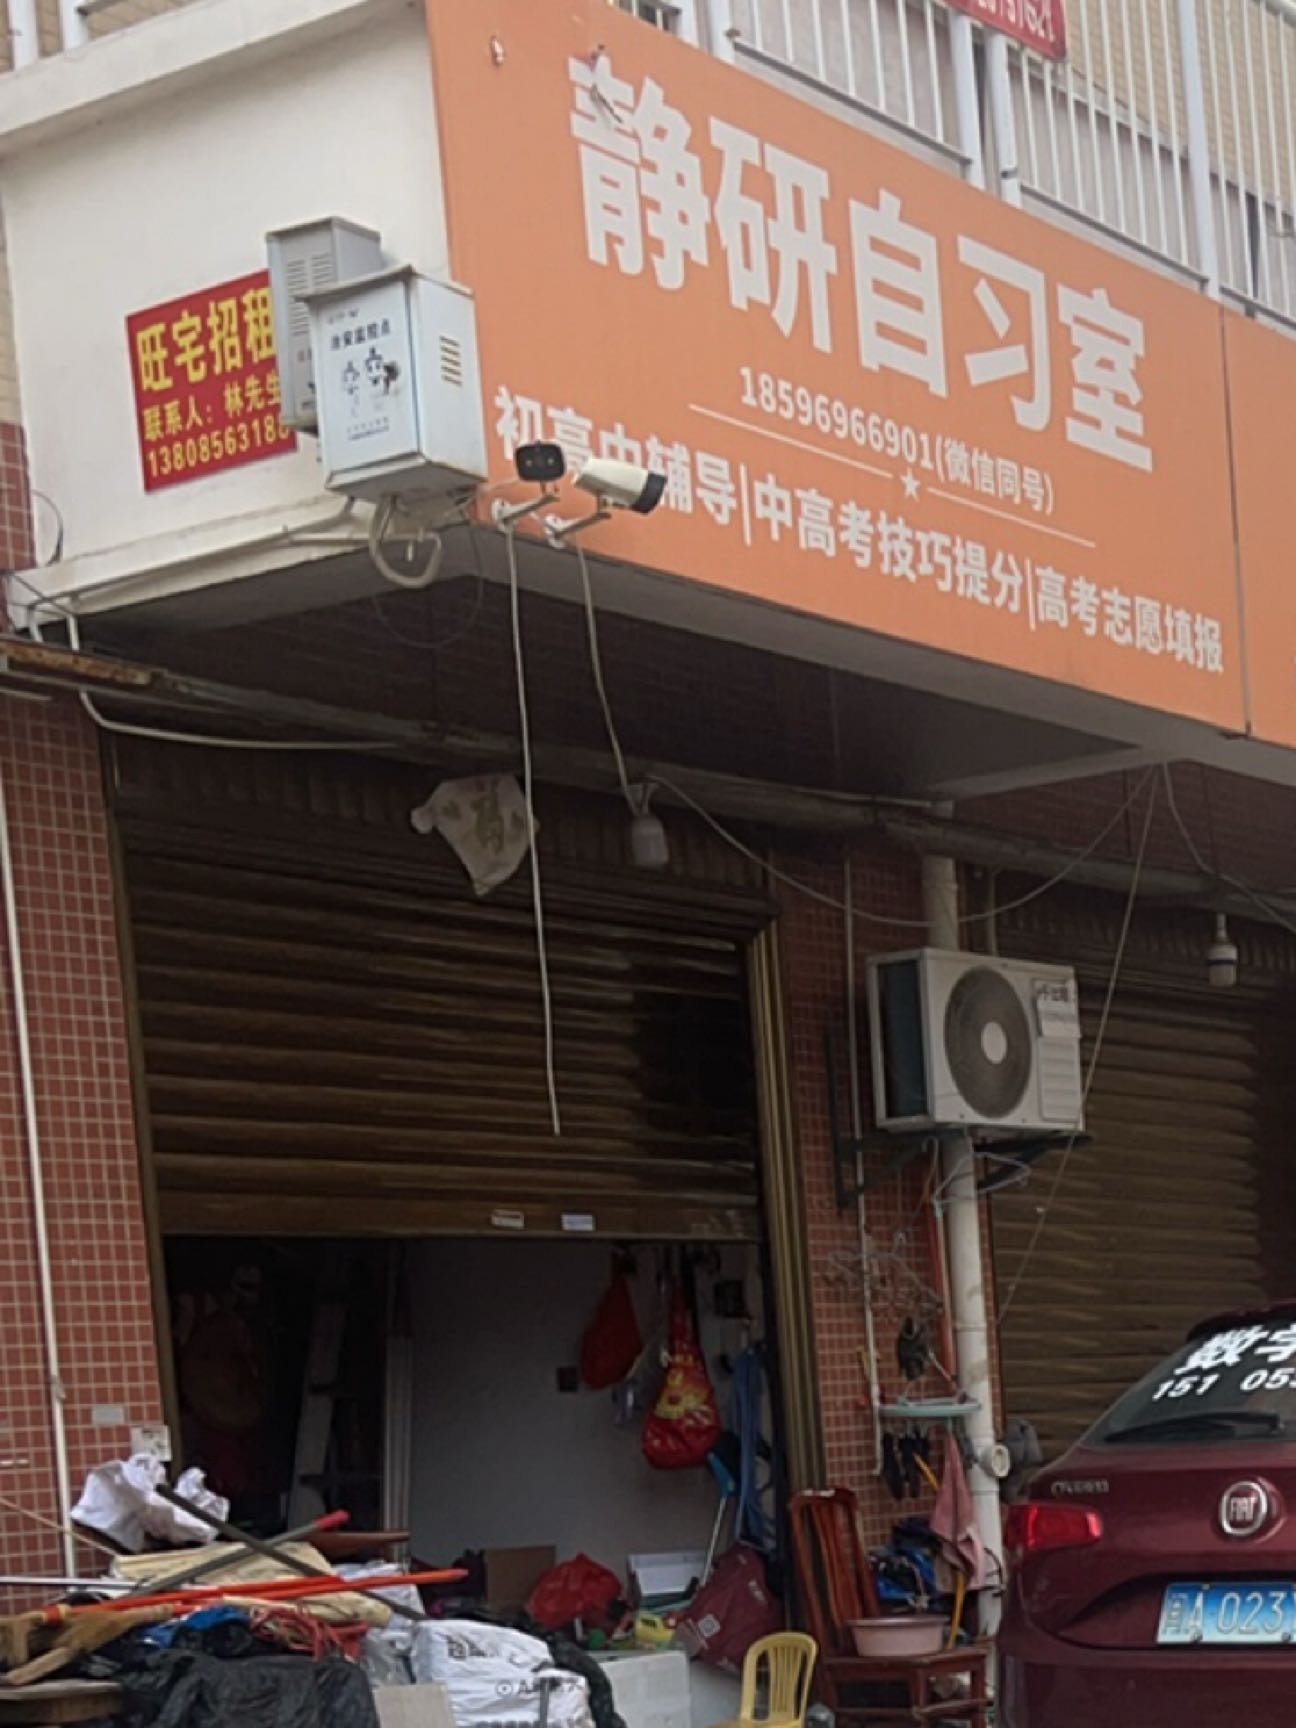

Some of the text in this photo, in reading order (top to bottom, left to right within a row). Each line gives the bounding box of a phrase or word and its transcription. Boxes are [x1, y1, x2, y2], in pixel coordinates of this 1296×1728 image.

[567, 53, 1153, 473] 静研自习室
[136, 287, 276, 392] 旺宅招租
[1151, 1374, 1220, 1402] 151
[1229, 1495, 1258, 1522] FIAT
